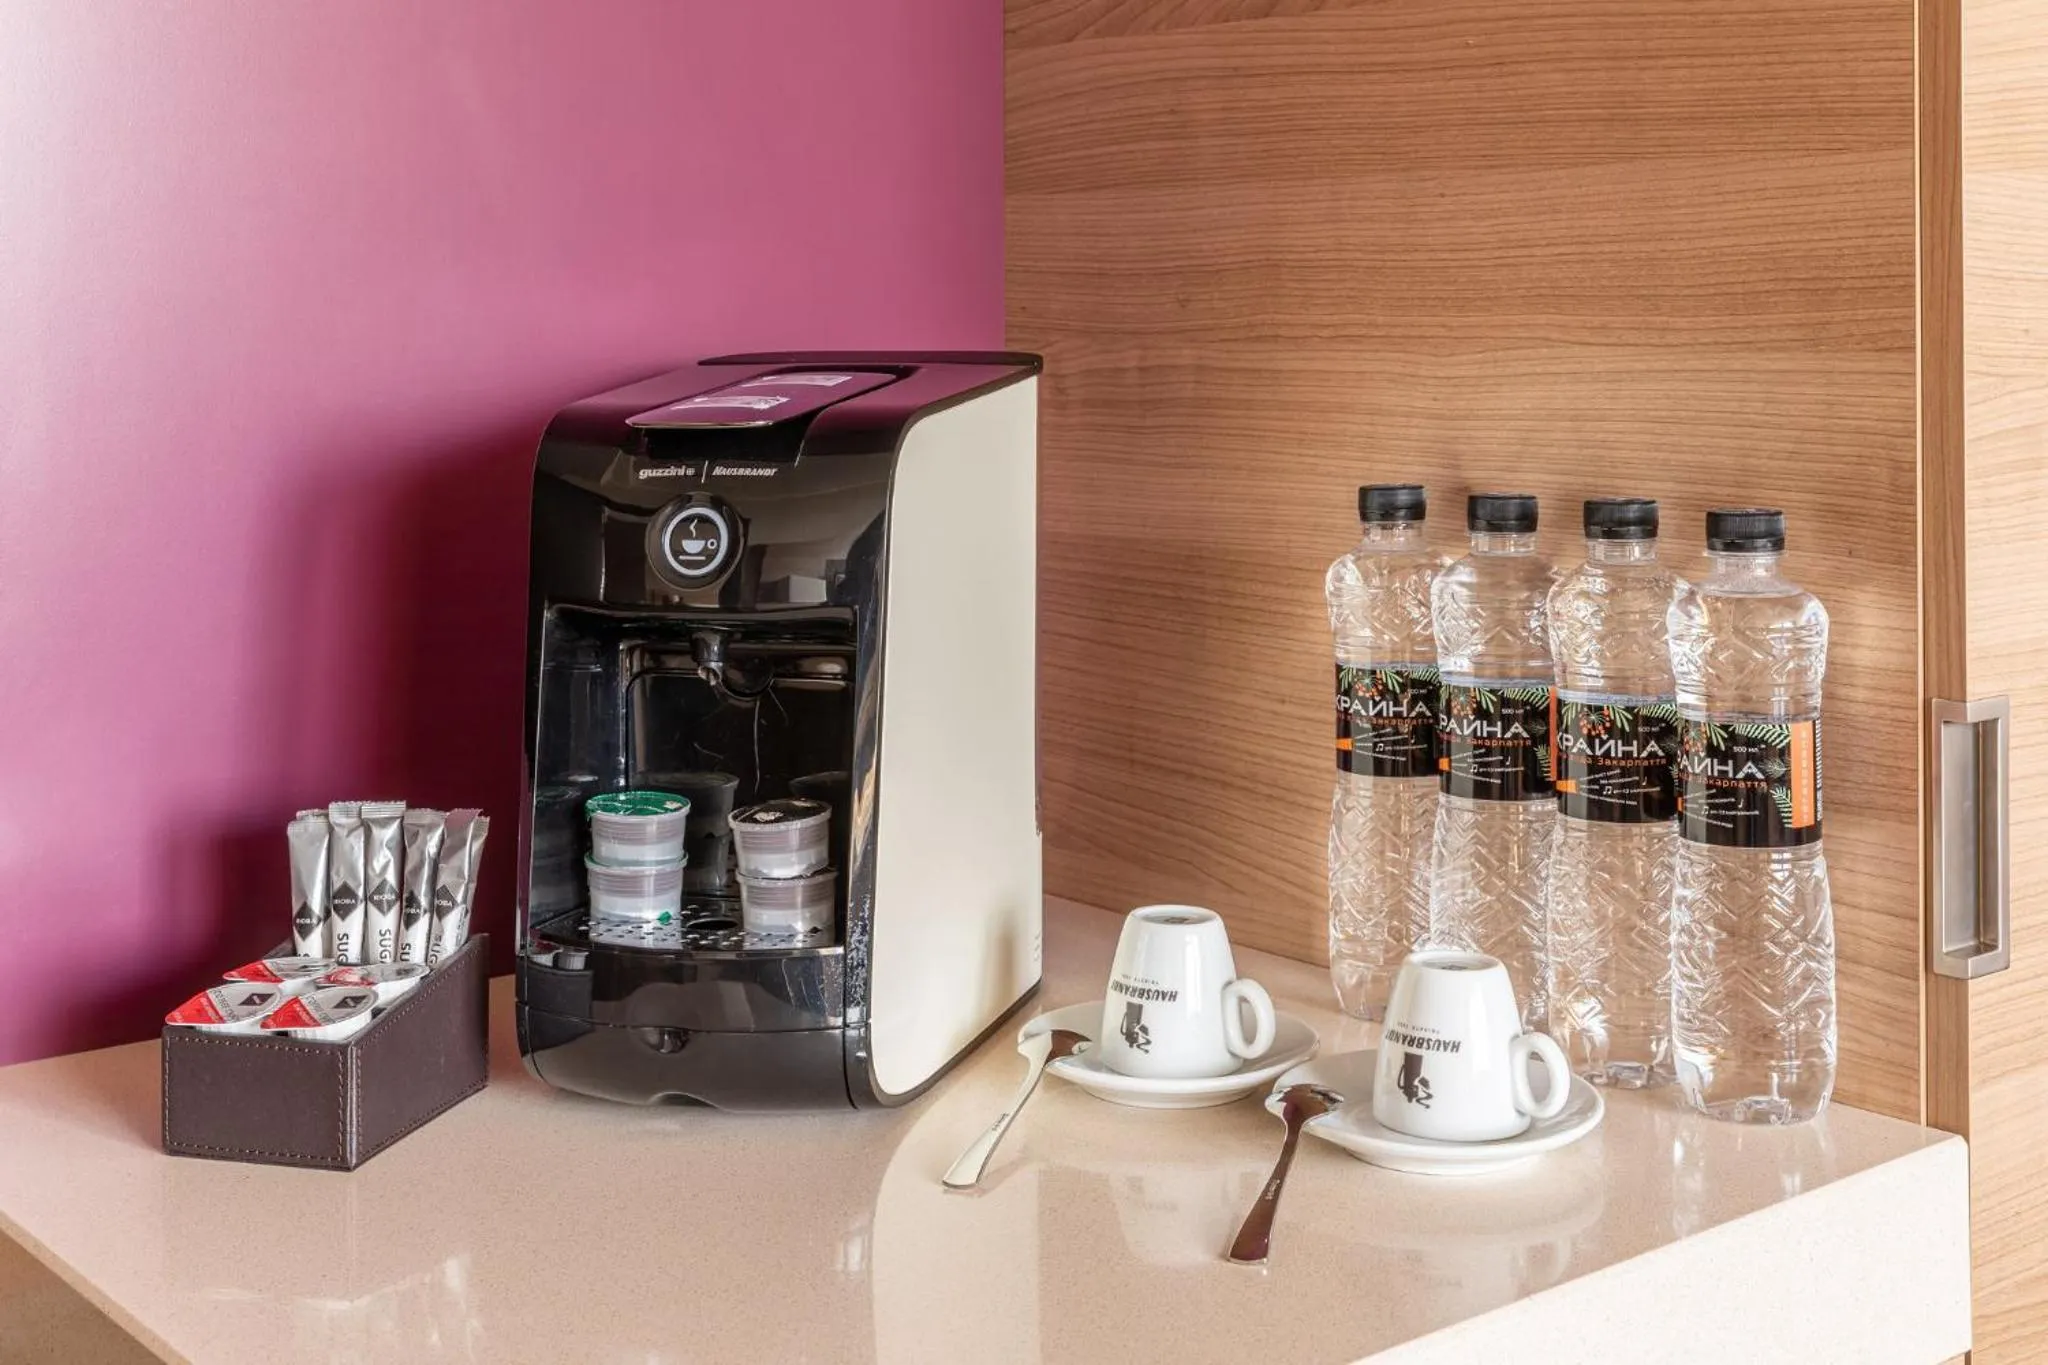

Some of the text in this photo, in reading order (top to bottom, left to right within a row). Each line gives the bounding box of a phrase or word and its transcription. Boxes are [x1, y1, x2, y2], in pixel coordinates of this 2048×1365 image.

[639, 465, 686, 479] guzzini
[712, 466, 778, 476] HAUSBRANDT
[379, 929, 391, 963] SUG
